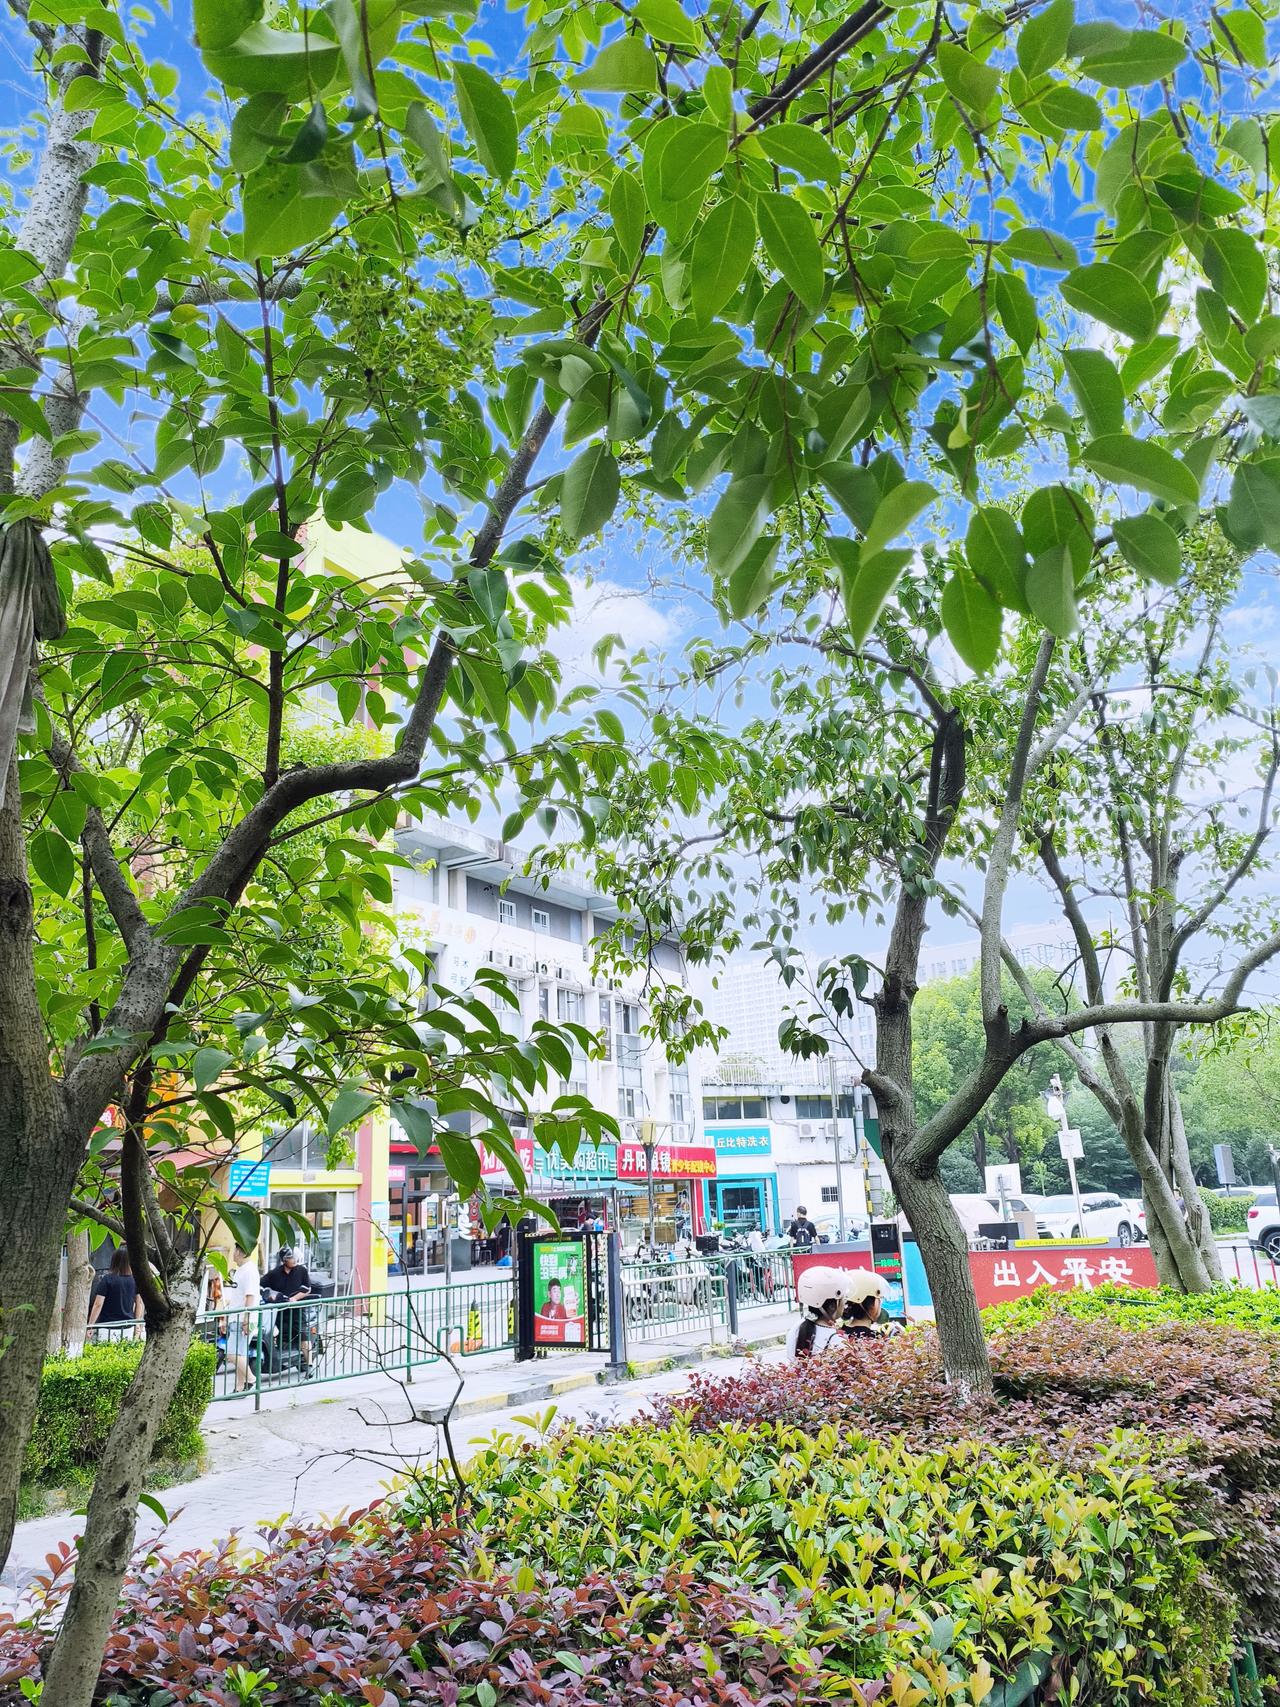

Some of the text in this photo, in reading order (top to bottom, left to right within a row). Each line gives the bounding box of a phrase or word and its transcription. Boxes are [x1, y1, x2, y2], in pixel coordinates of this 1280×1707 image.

[715, 1135, 769, 1148] 丘比特洗衣
[621, 1148, 671, 1174] 丹阳眼镜
[993, 1256, 1133, 1291] 出入平安
